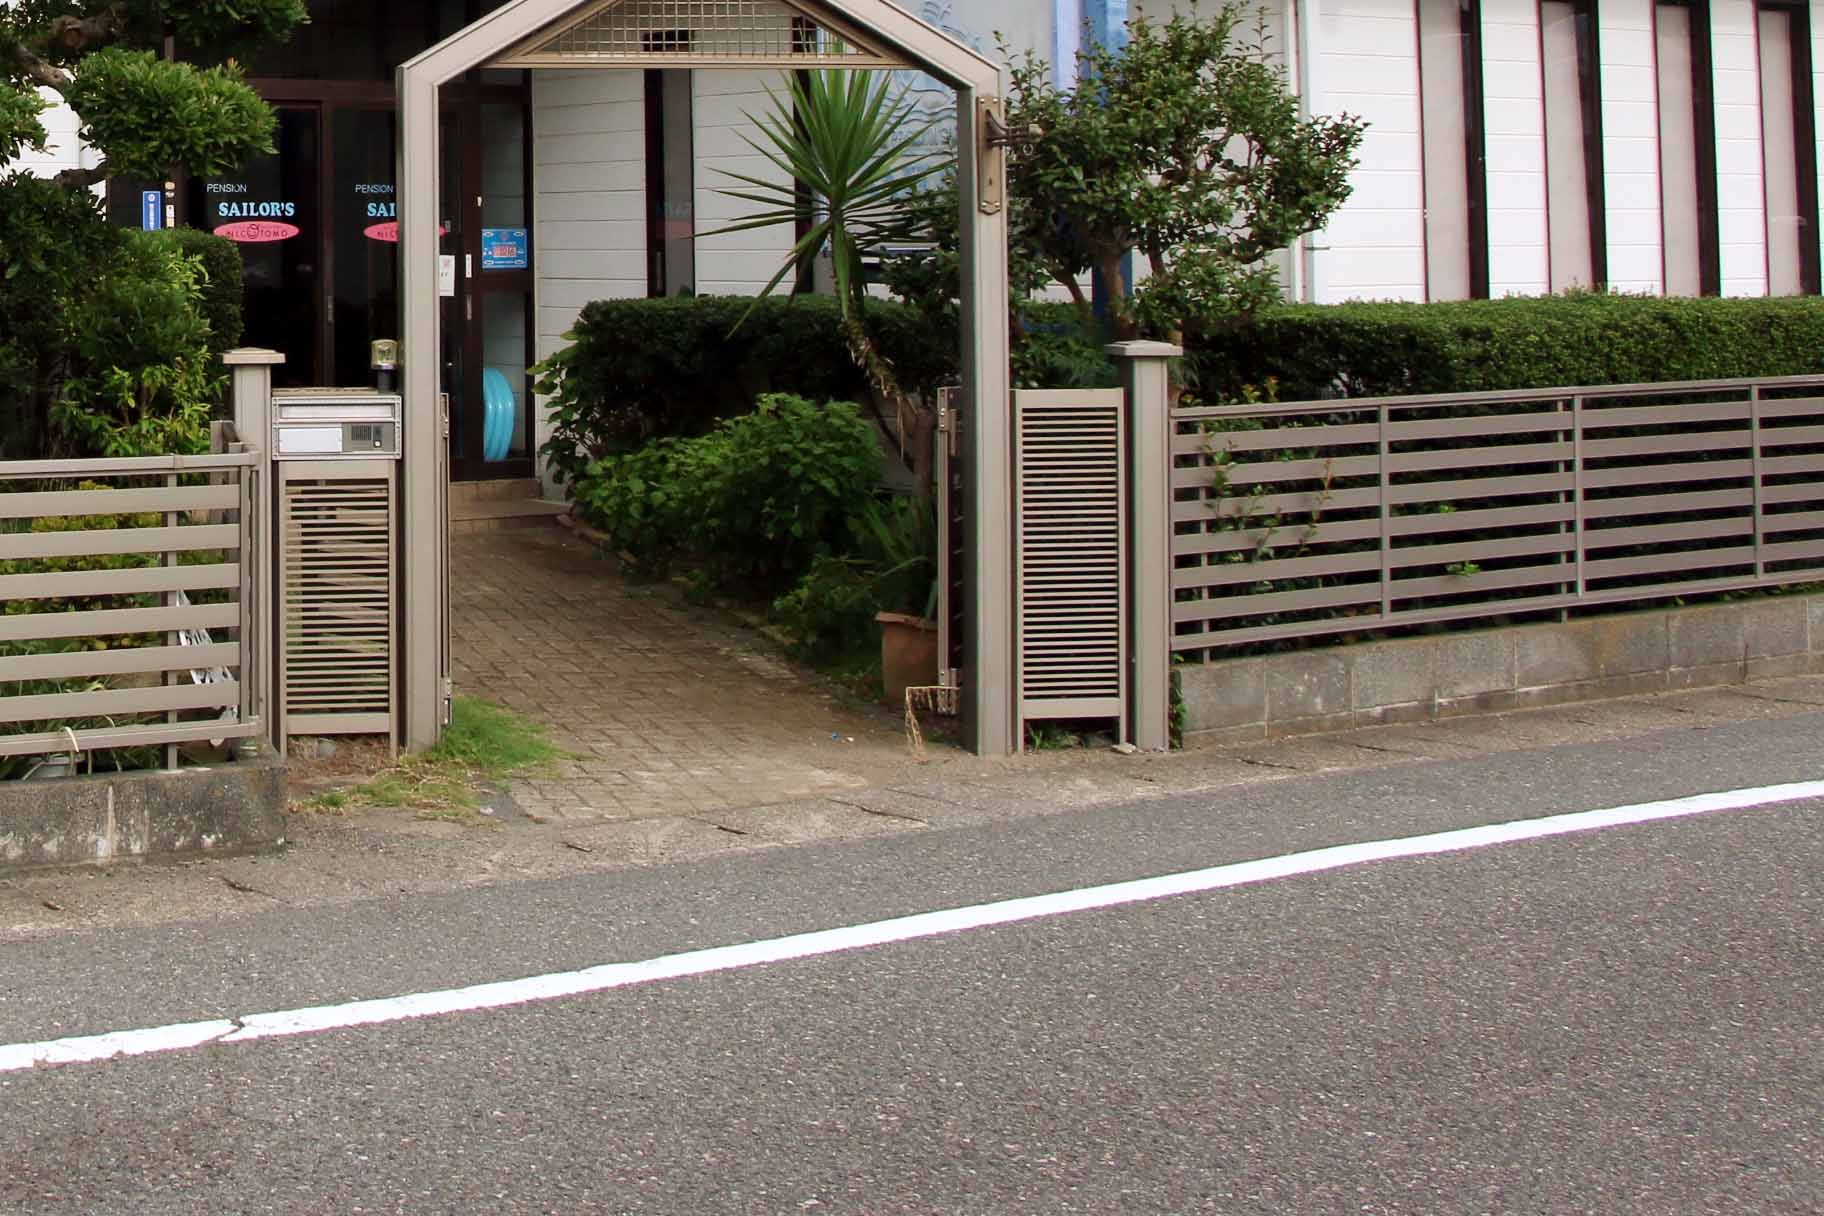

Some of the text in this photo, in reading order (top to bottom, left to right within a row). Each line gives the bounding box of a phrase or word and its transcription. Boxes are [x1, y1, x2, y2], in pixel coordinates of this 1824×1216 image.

[206, 183, 247, 193] PENSION
[355, 184, 394, 193] PENSION
[218, 202, 295, 217] SAILOR'S
